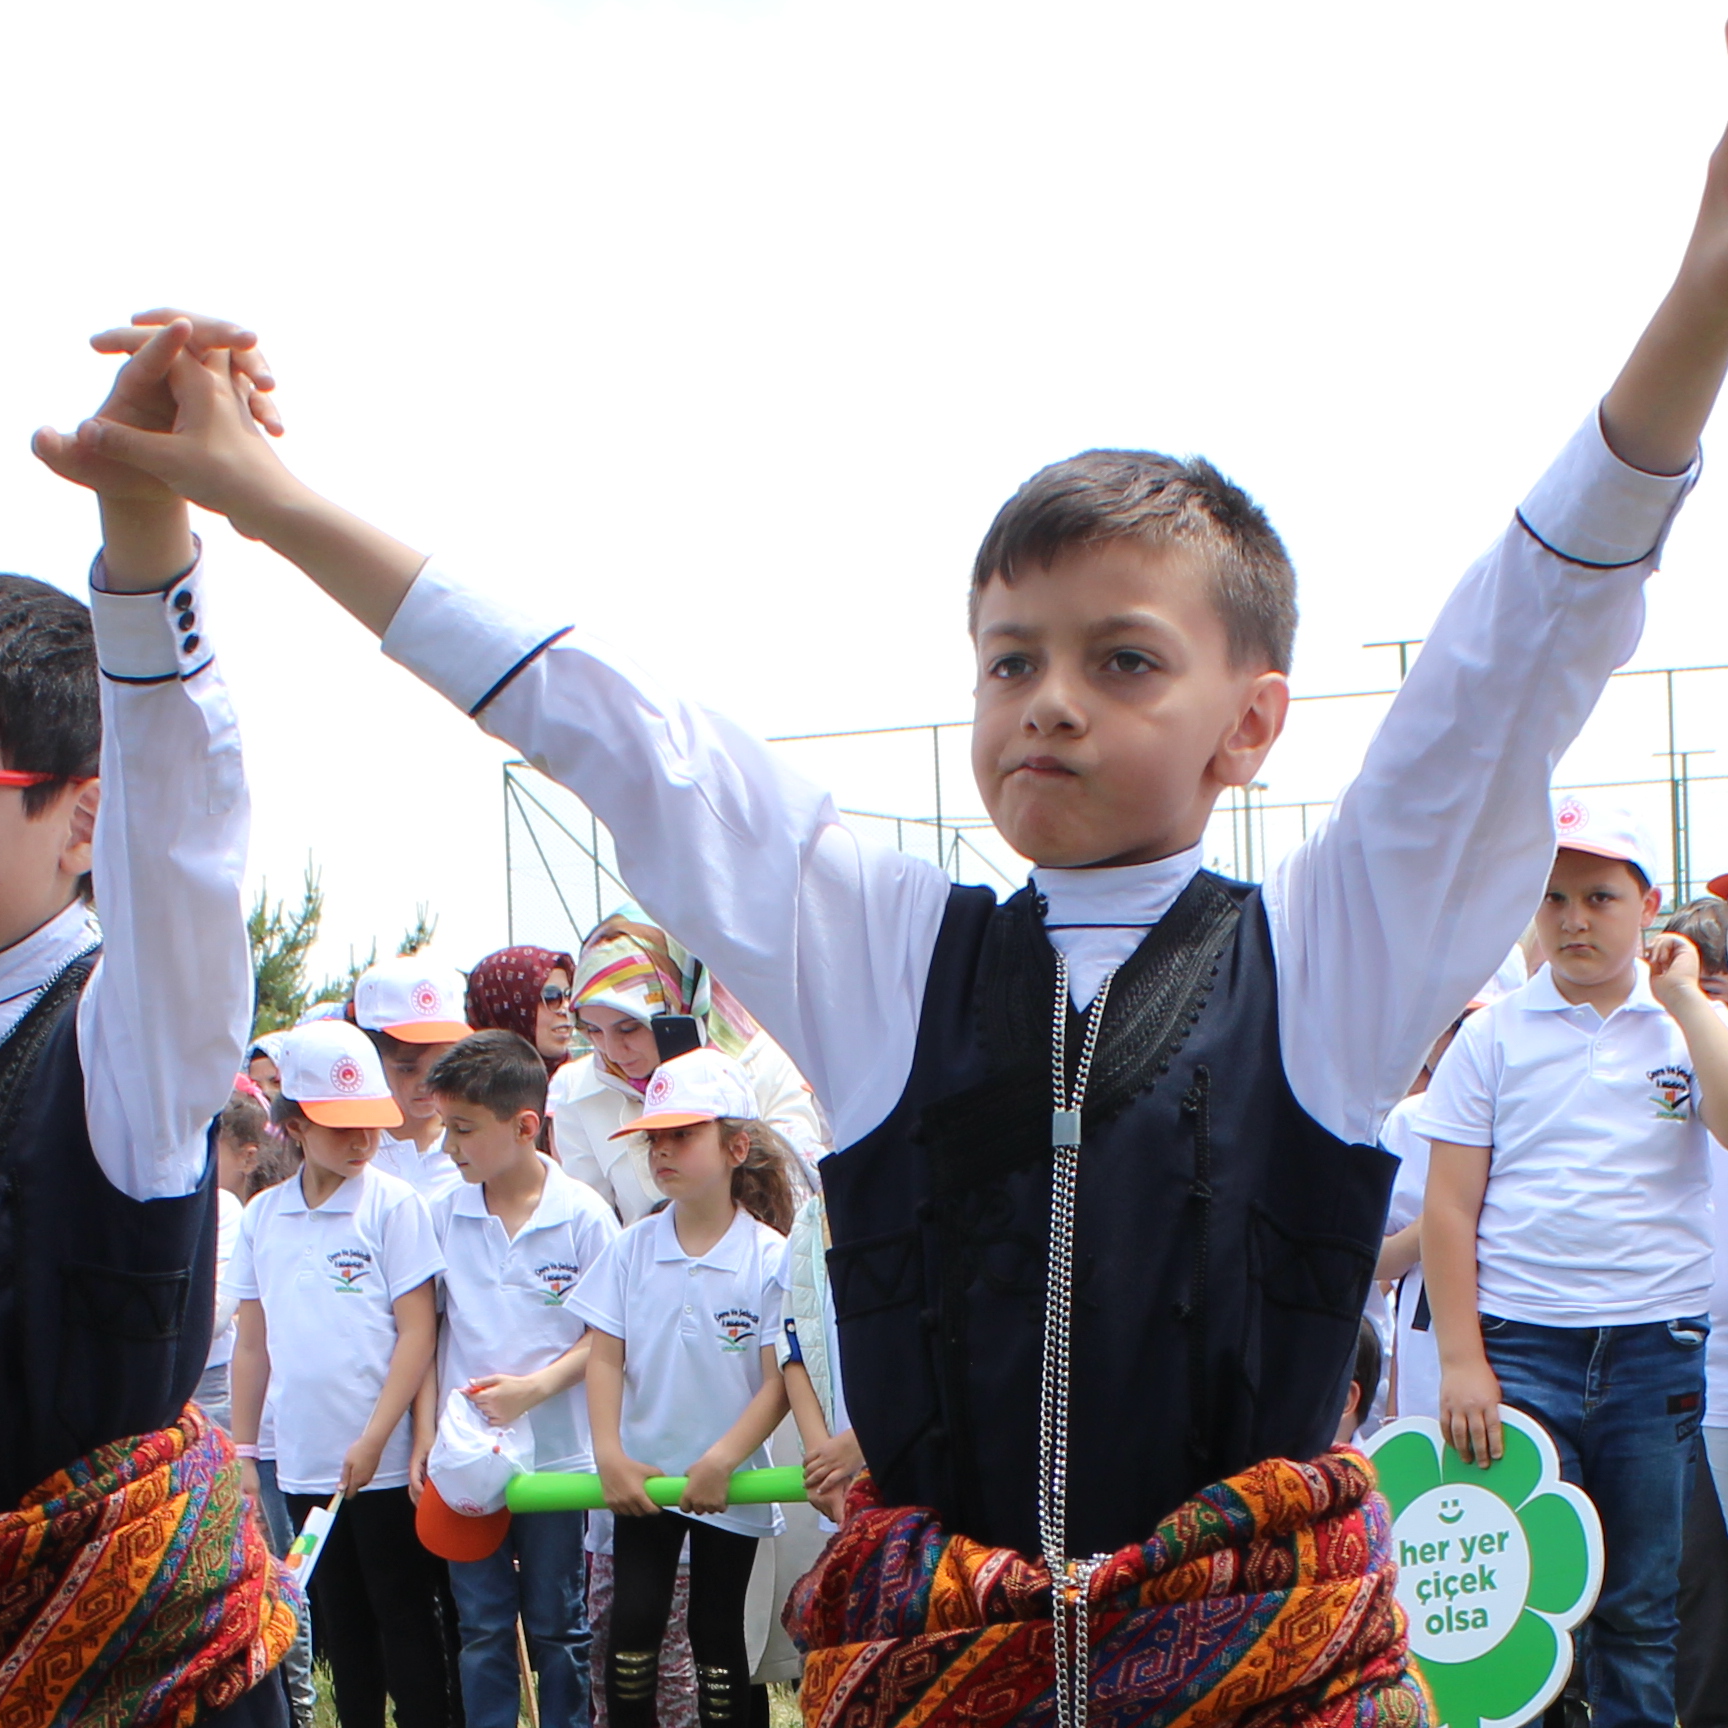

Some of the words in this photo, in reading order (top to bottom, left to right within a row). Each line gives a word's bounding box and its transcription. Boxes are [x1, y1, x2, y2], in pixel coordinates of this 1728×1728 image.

[1399, 1540, 1450, 1567] her
[1459, 1530, 1510, 1563] yer
[1416, 1564, 1497, 1606] çiçek
[1425, 1605, 1489, 1635] olsa
